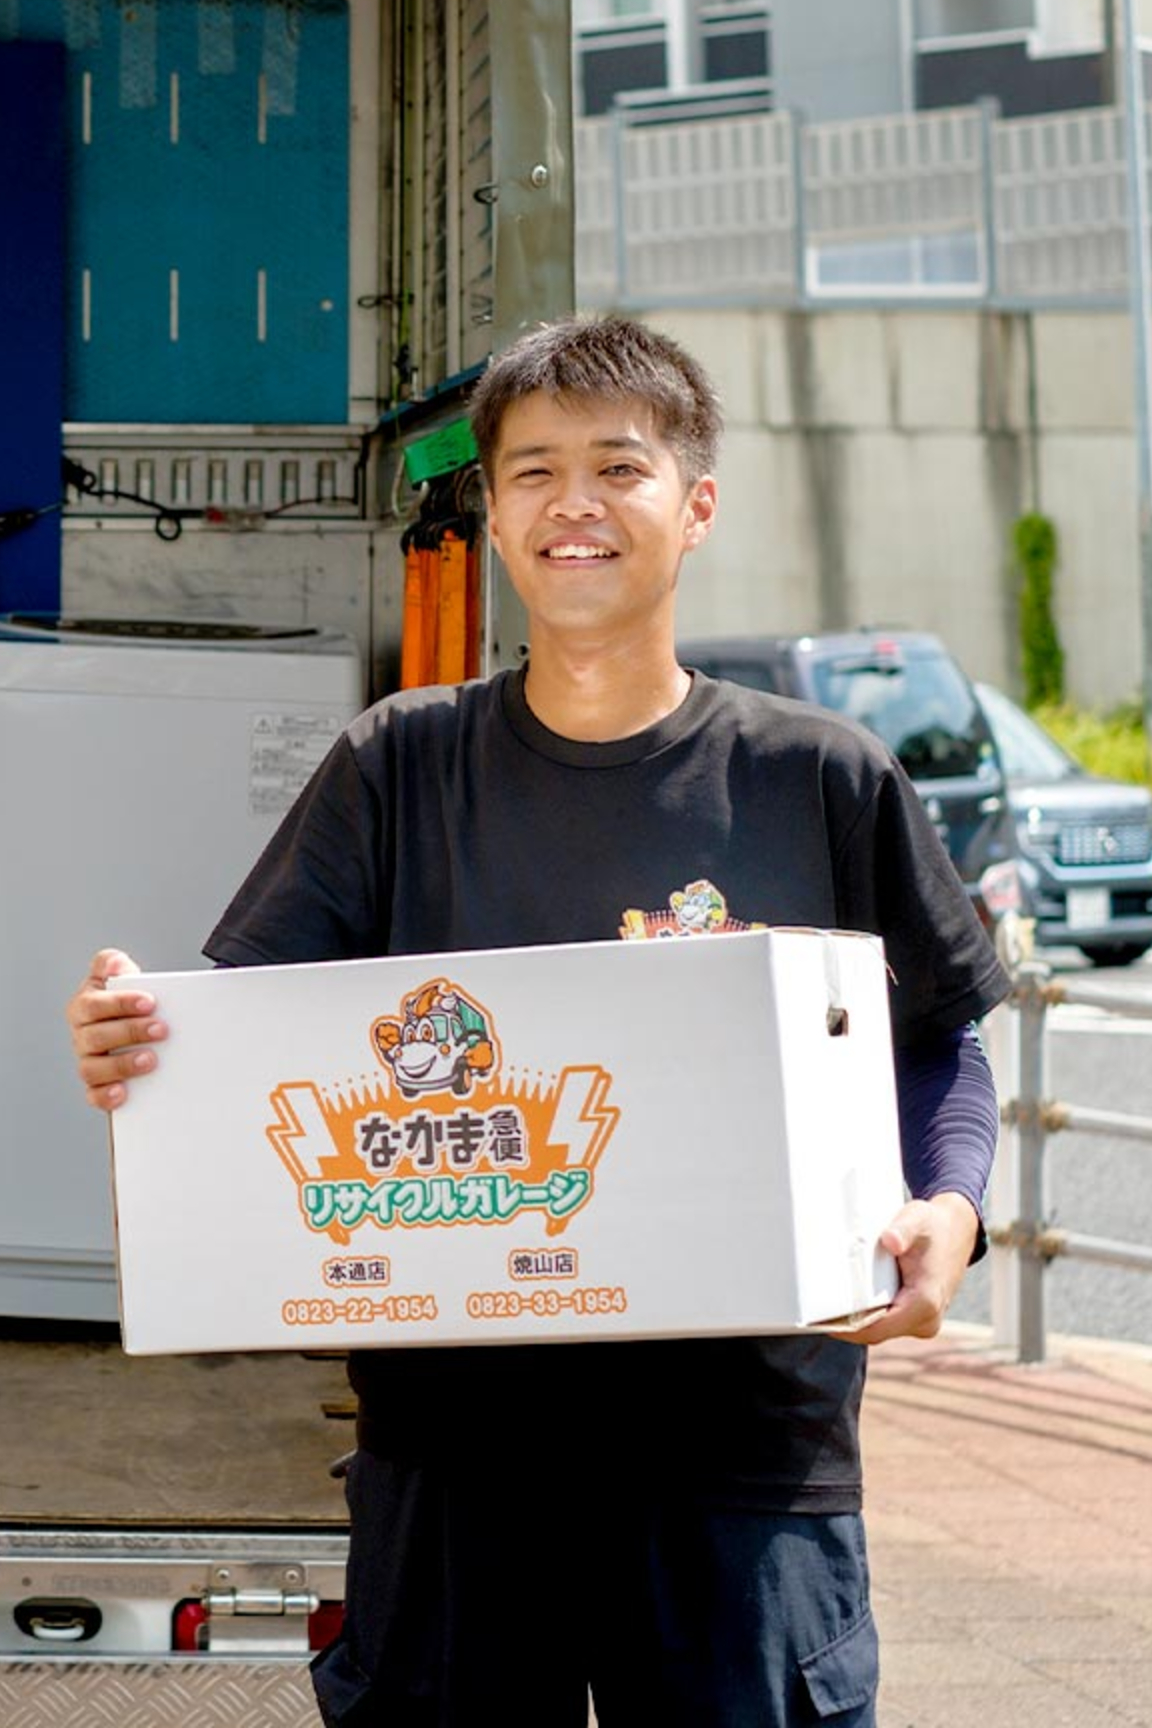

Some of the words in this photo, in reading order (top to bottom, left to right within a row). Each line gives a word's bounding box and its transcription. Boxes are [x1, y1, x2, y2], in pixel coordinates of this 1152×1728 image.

[303, 1171, 589, 1228] リサイクルガレージ
[328, 1261, 386, 1283] 本通店
[513, 1253, 574, 1276] 焼山店
[283, 1297, 437, 1324] 0823-22-1954
[467, 1289, 626, 1317] 0823-33-1954
